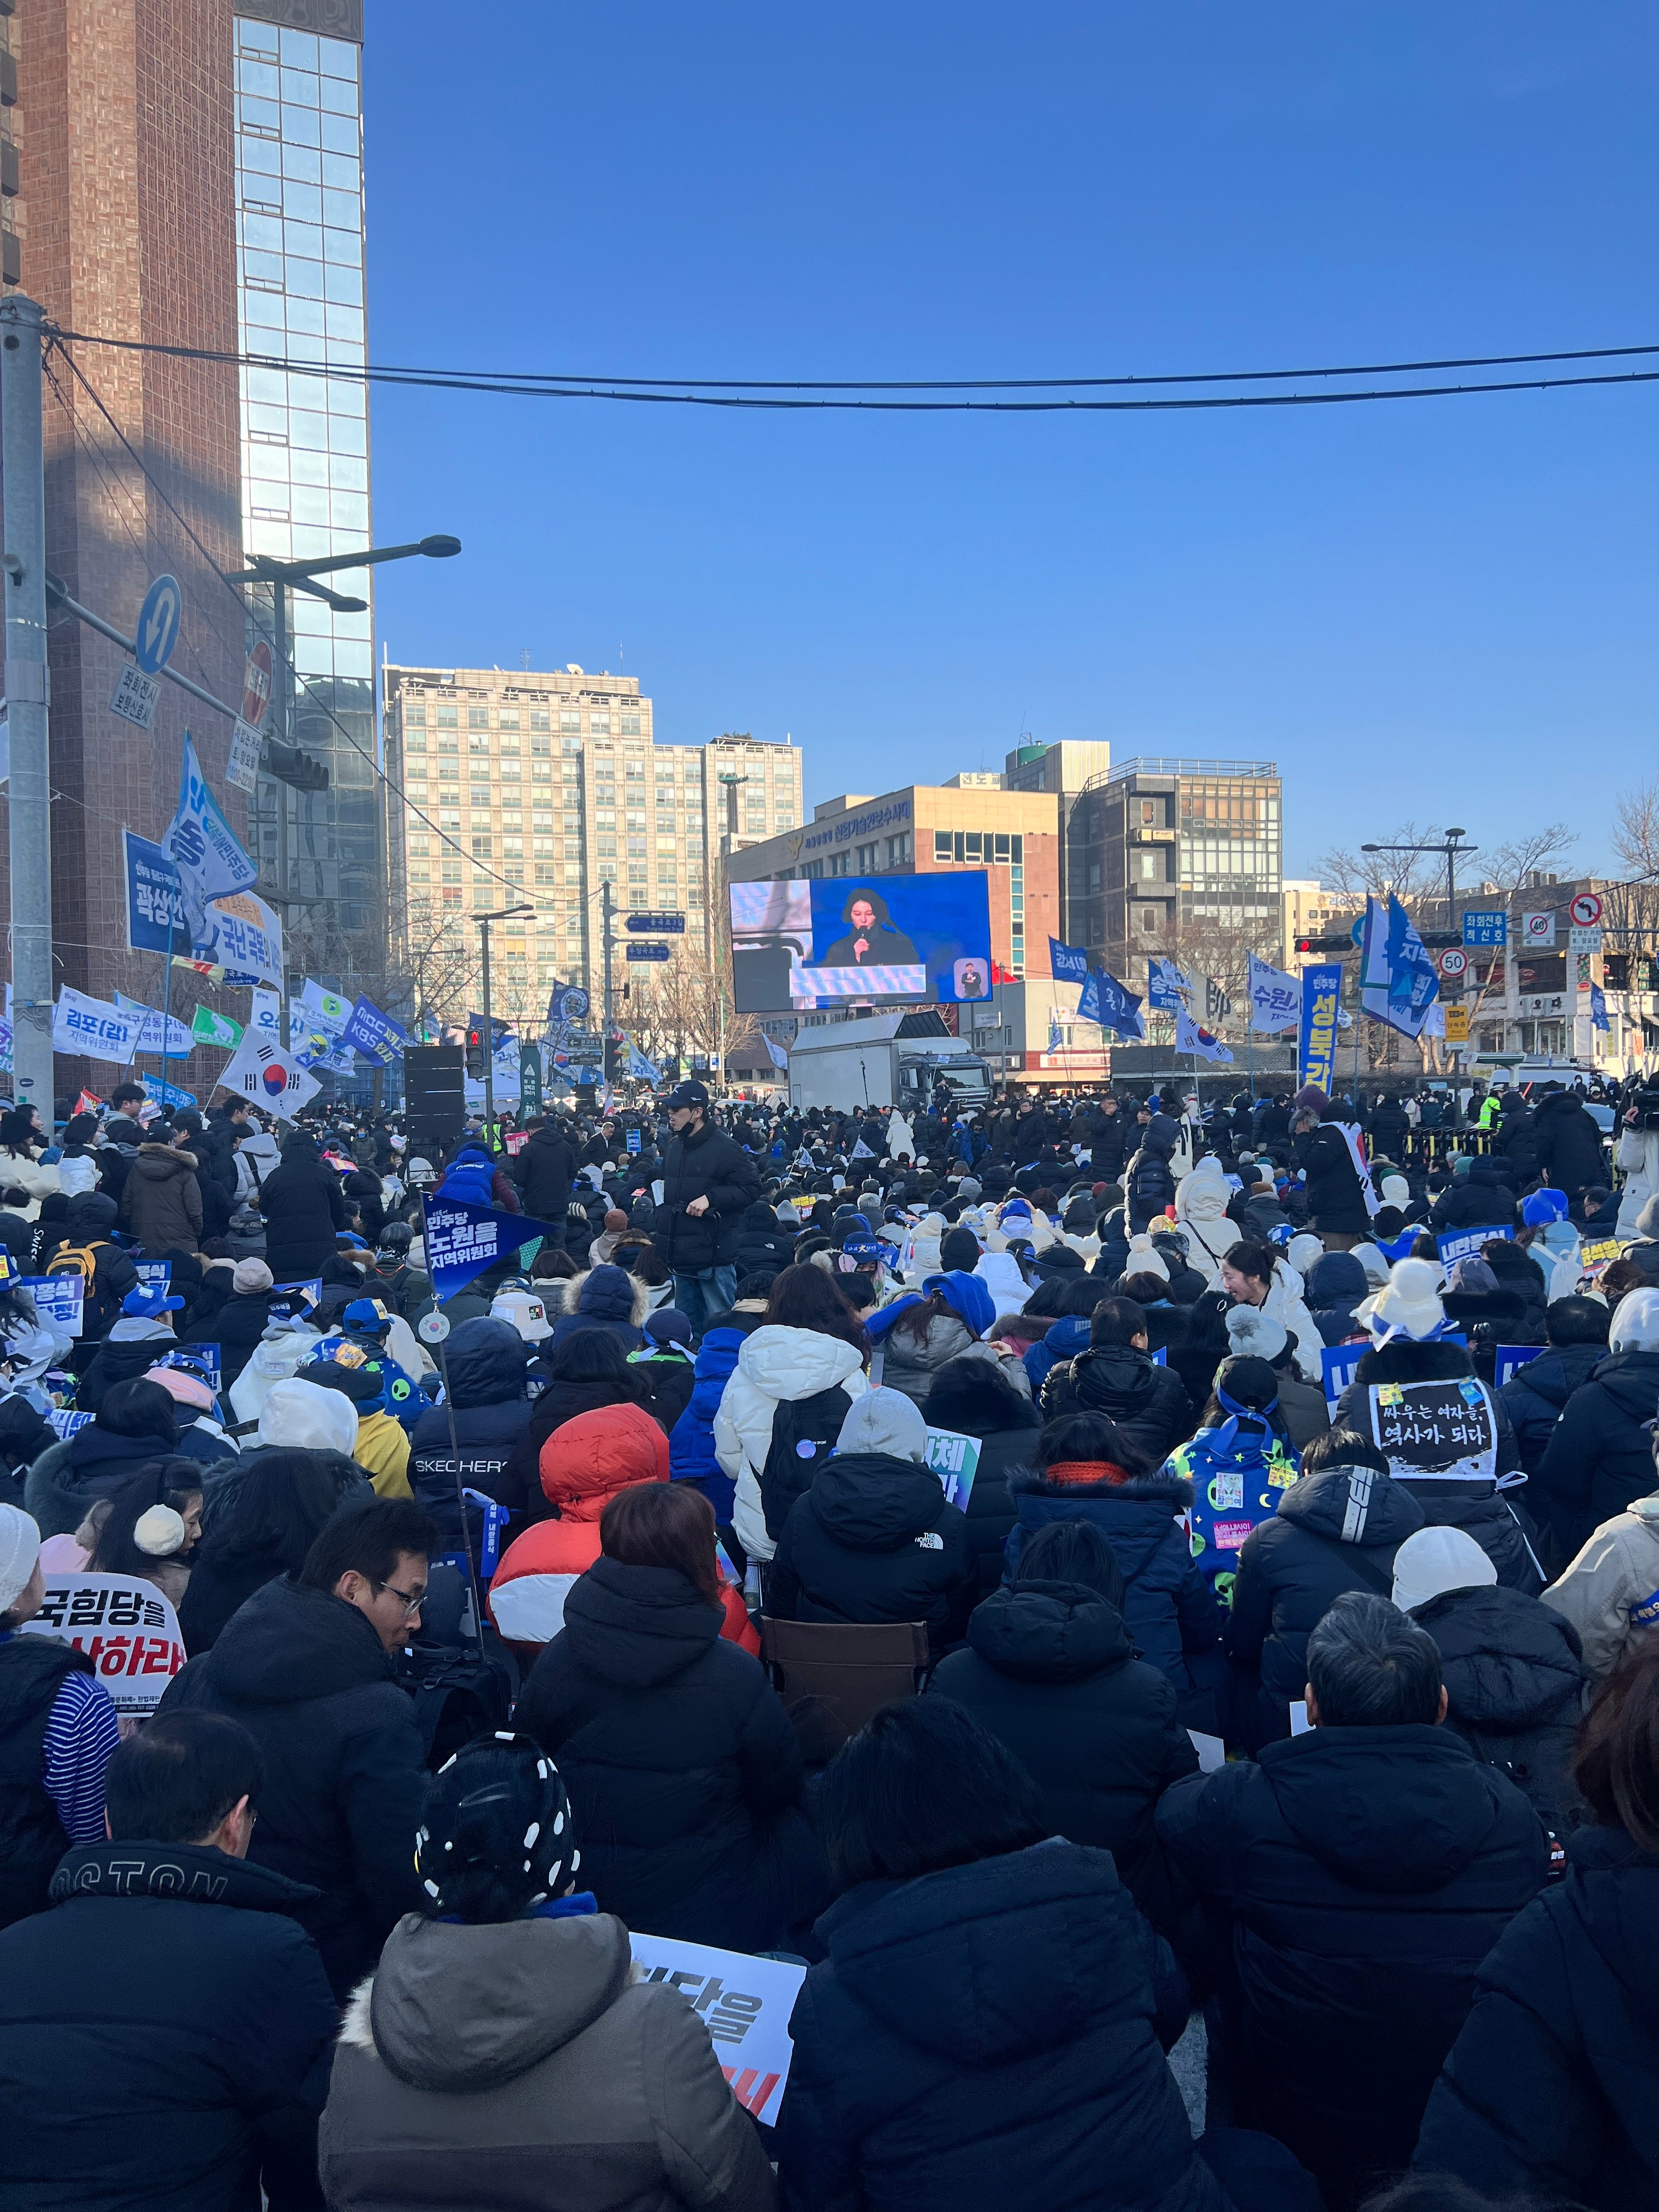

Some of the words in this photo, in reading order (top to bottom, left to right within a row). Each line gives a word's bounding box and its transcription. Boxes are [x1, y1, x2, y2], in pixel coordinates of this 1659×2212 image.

[123, 670, 158, 704] 좌회전시
[650, 918, 683, 926] 율곡로3길
[1466, 915, 1503, 927] 좌회전후
[1533, 921, 1544, 929] 40
[1444, 956, 1462, 969] 50
[1312, 978, 1337, 990] 민주당
[66, 1009, 128, 1042] 김포(갑)
[69, 1030, 119, 1053] 지역위원회
[138, 1031, 183, 1043] 역위원회
[427, 1211, 468, 1231] 민주당
[428, 1222, 498, 1254] 노원을
[430, 1242, 498, 1270] 지역위원회
[1384, 1404, 1432, 1421] 싸우는
[1382, 1423, 1446, 1446] 역사가
[1451, 1424, 1487, 1446] 되다
[415, 1460, 508, 1473] SKECHER
[32, 1589, 165, 1628] 국힘당을
[643, 1967, 763, 2044] 당을
